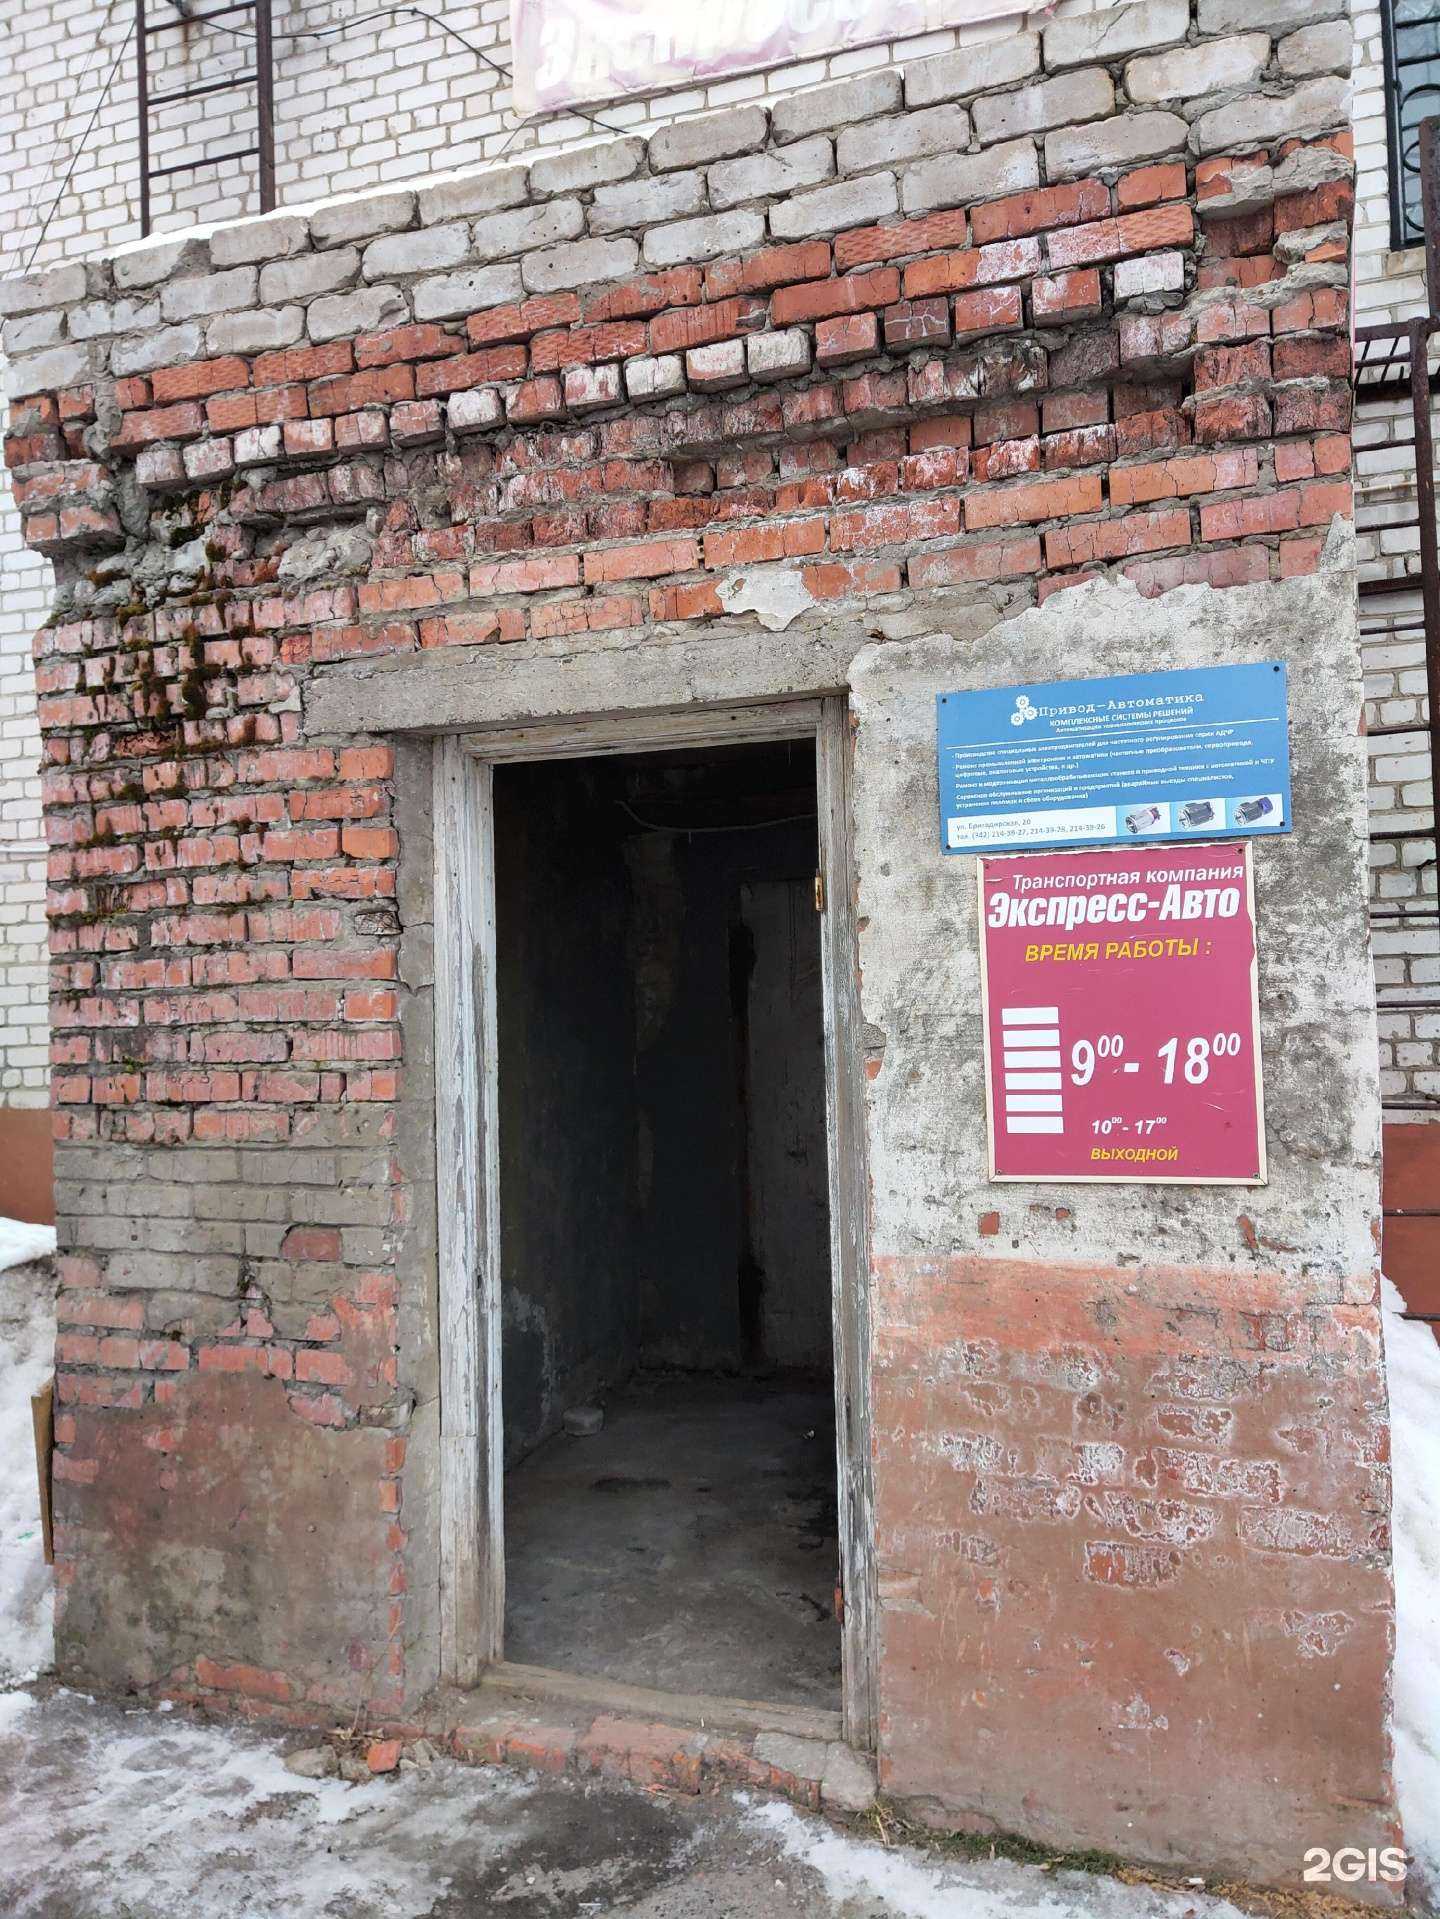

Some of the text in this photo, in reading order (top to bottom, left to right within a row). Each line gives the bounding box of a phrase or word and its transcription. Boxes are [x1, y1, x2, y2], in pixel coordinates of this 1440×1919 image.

[1049, 707, 1193, 726] КОМПЛЕКСНЫЕ СИСТЕМЫ РЕШЕНИЙ
[1013, 865, 1243, 891] Транспортная компания
[988, 884, 1240, 930] Экспресс-Авто
[1025, 942, 1099, 962] ВРЕМЯ
[1091, 1146, 1179, 1161] ВЫХОДНОЙ
